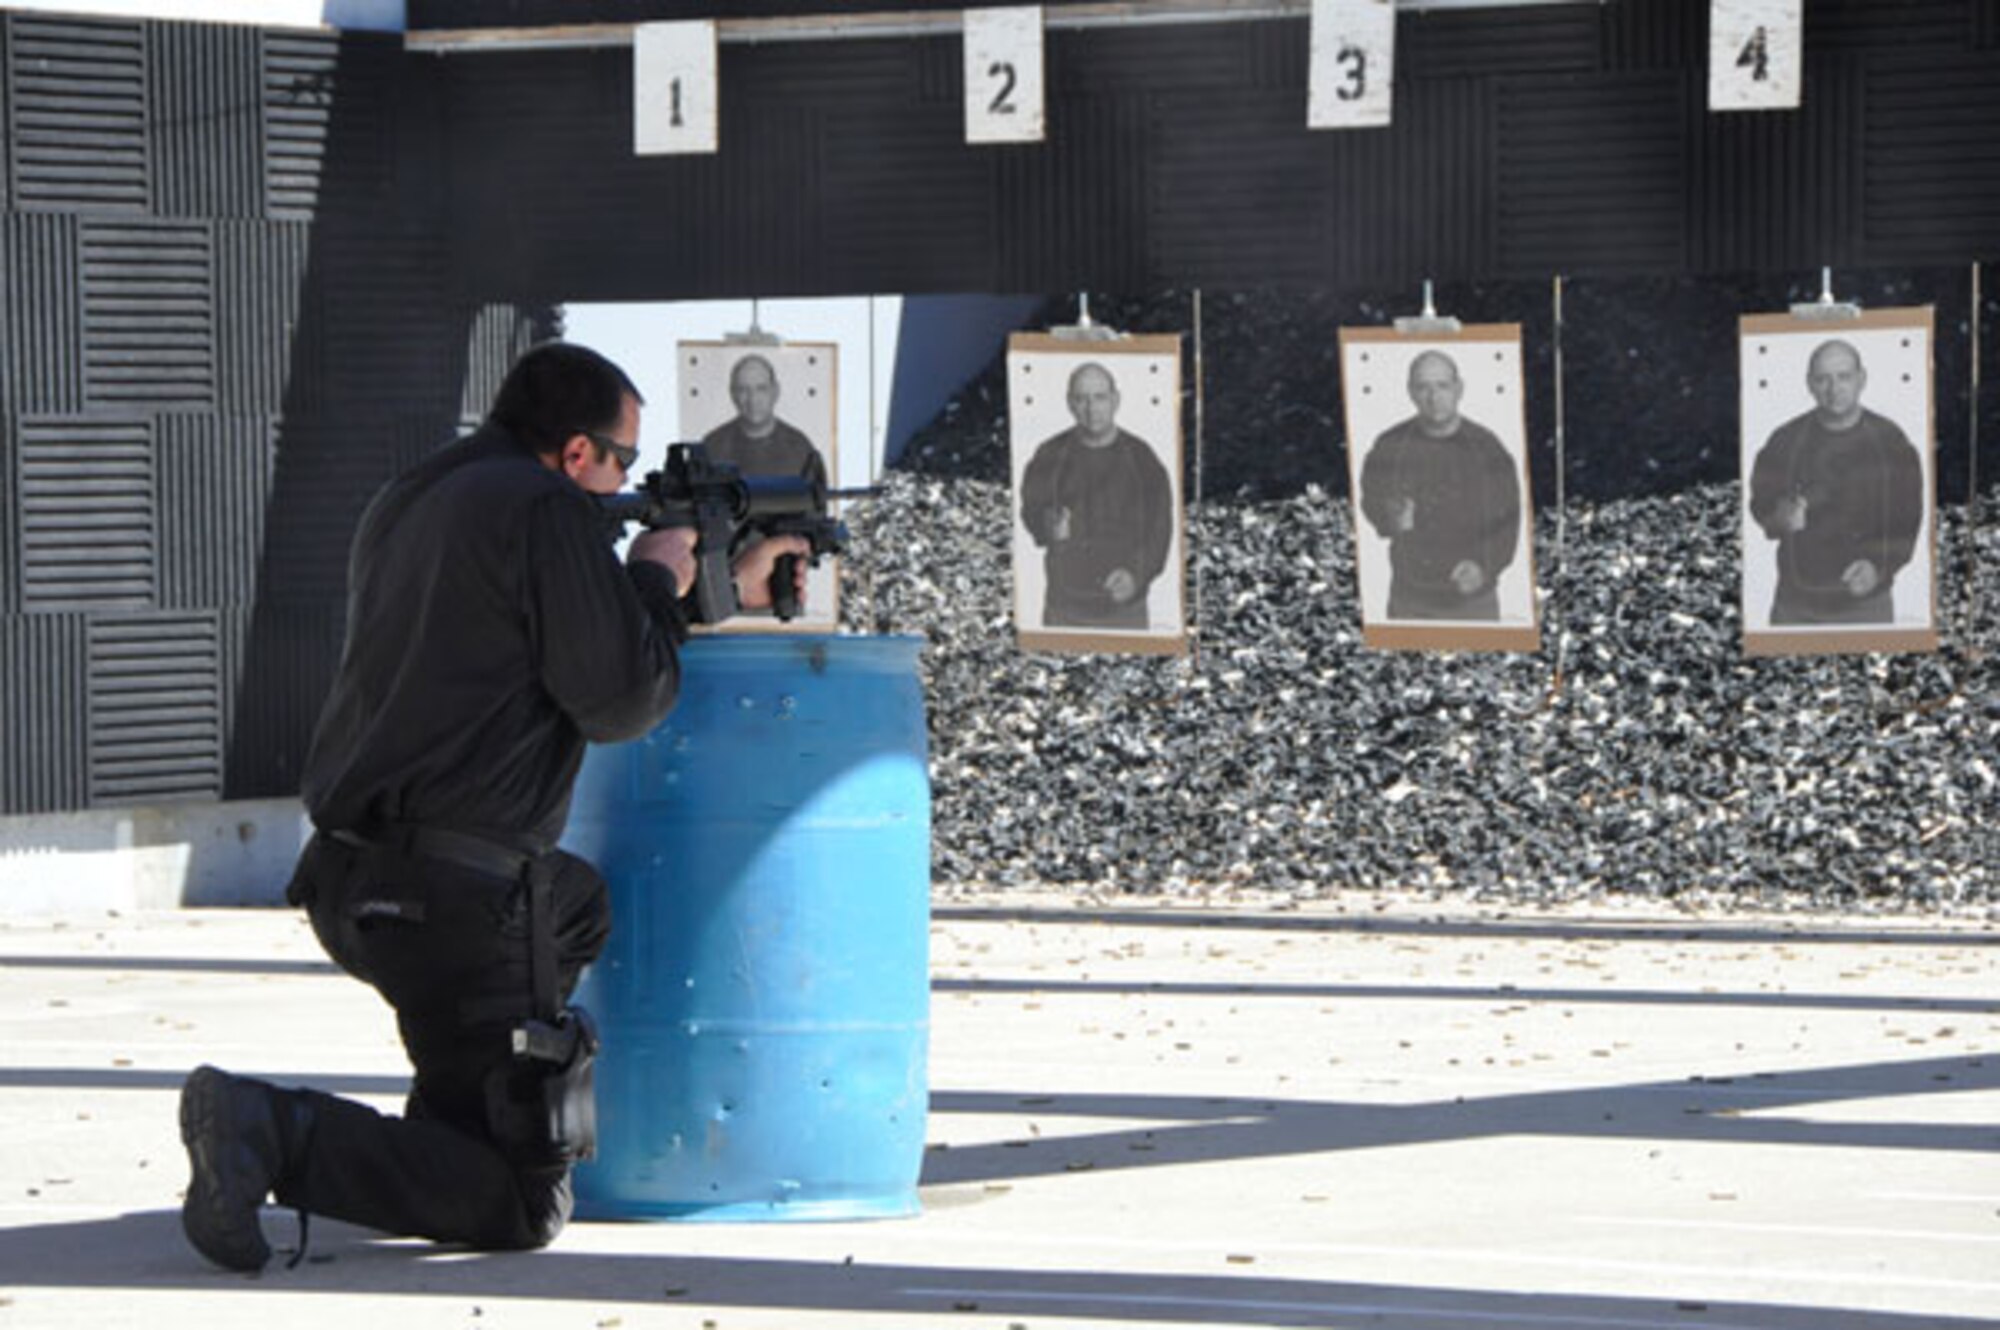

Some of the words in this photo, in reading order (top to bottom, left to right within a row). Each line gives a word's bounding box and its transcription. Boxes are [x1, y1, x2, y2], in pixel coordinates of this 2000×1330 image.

[1336, 48, 1367, 101] 3
[1735, 26, 1769, 82] 4
[669, 77, 683, 127] 1
[987, 62, 1017, 115] 2
